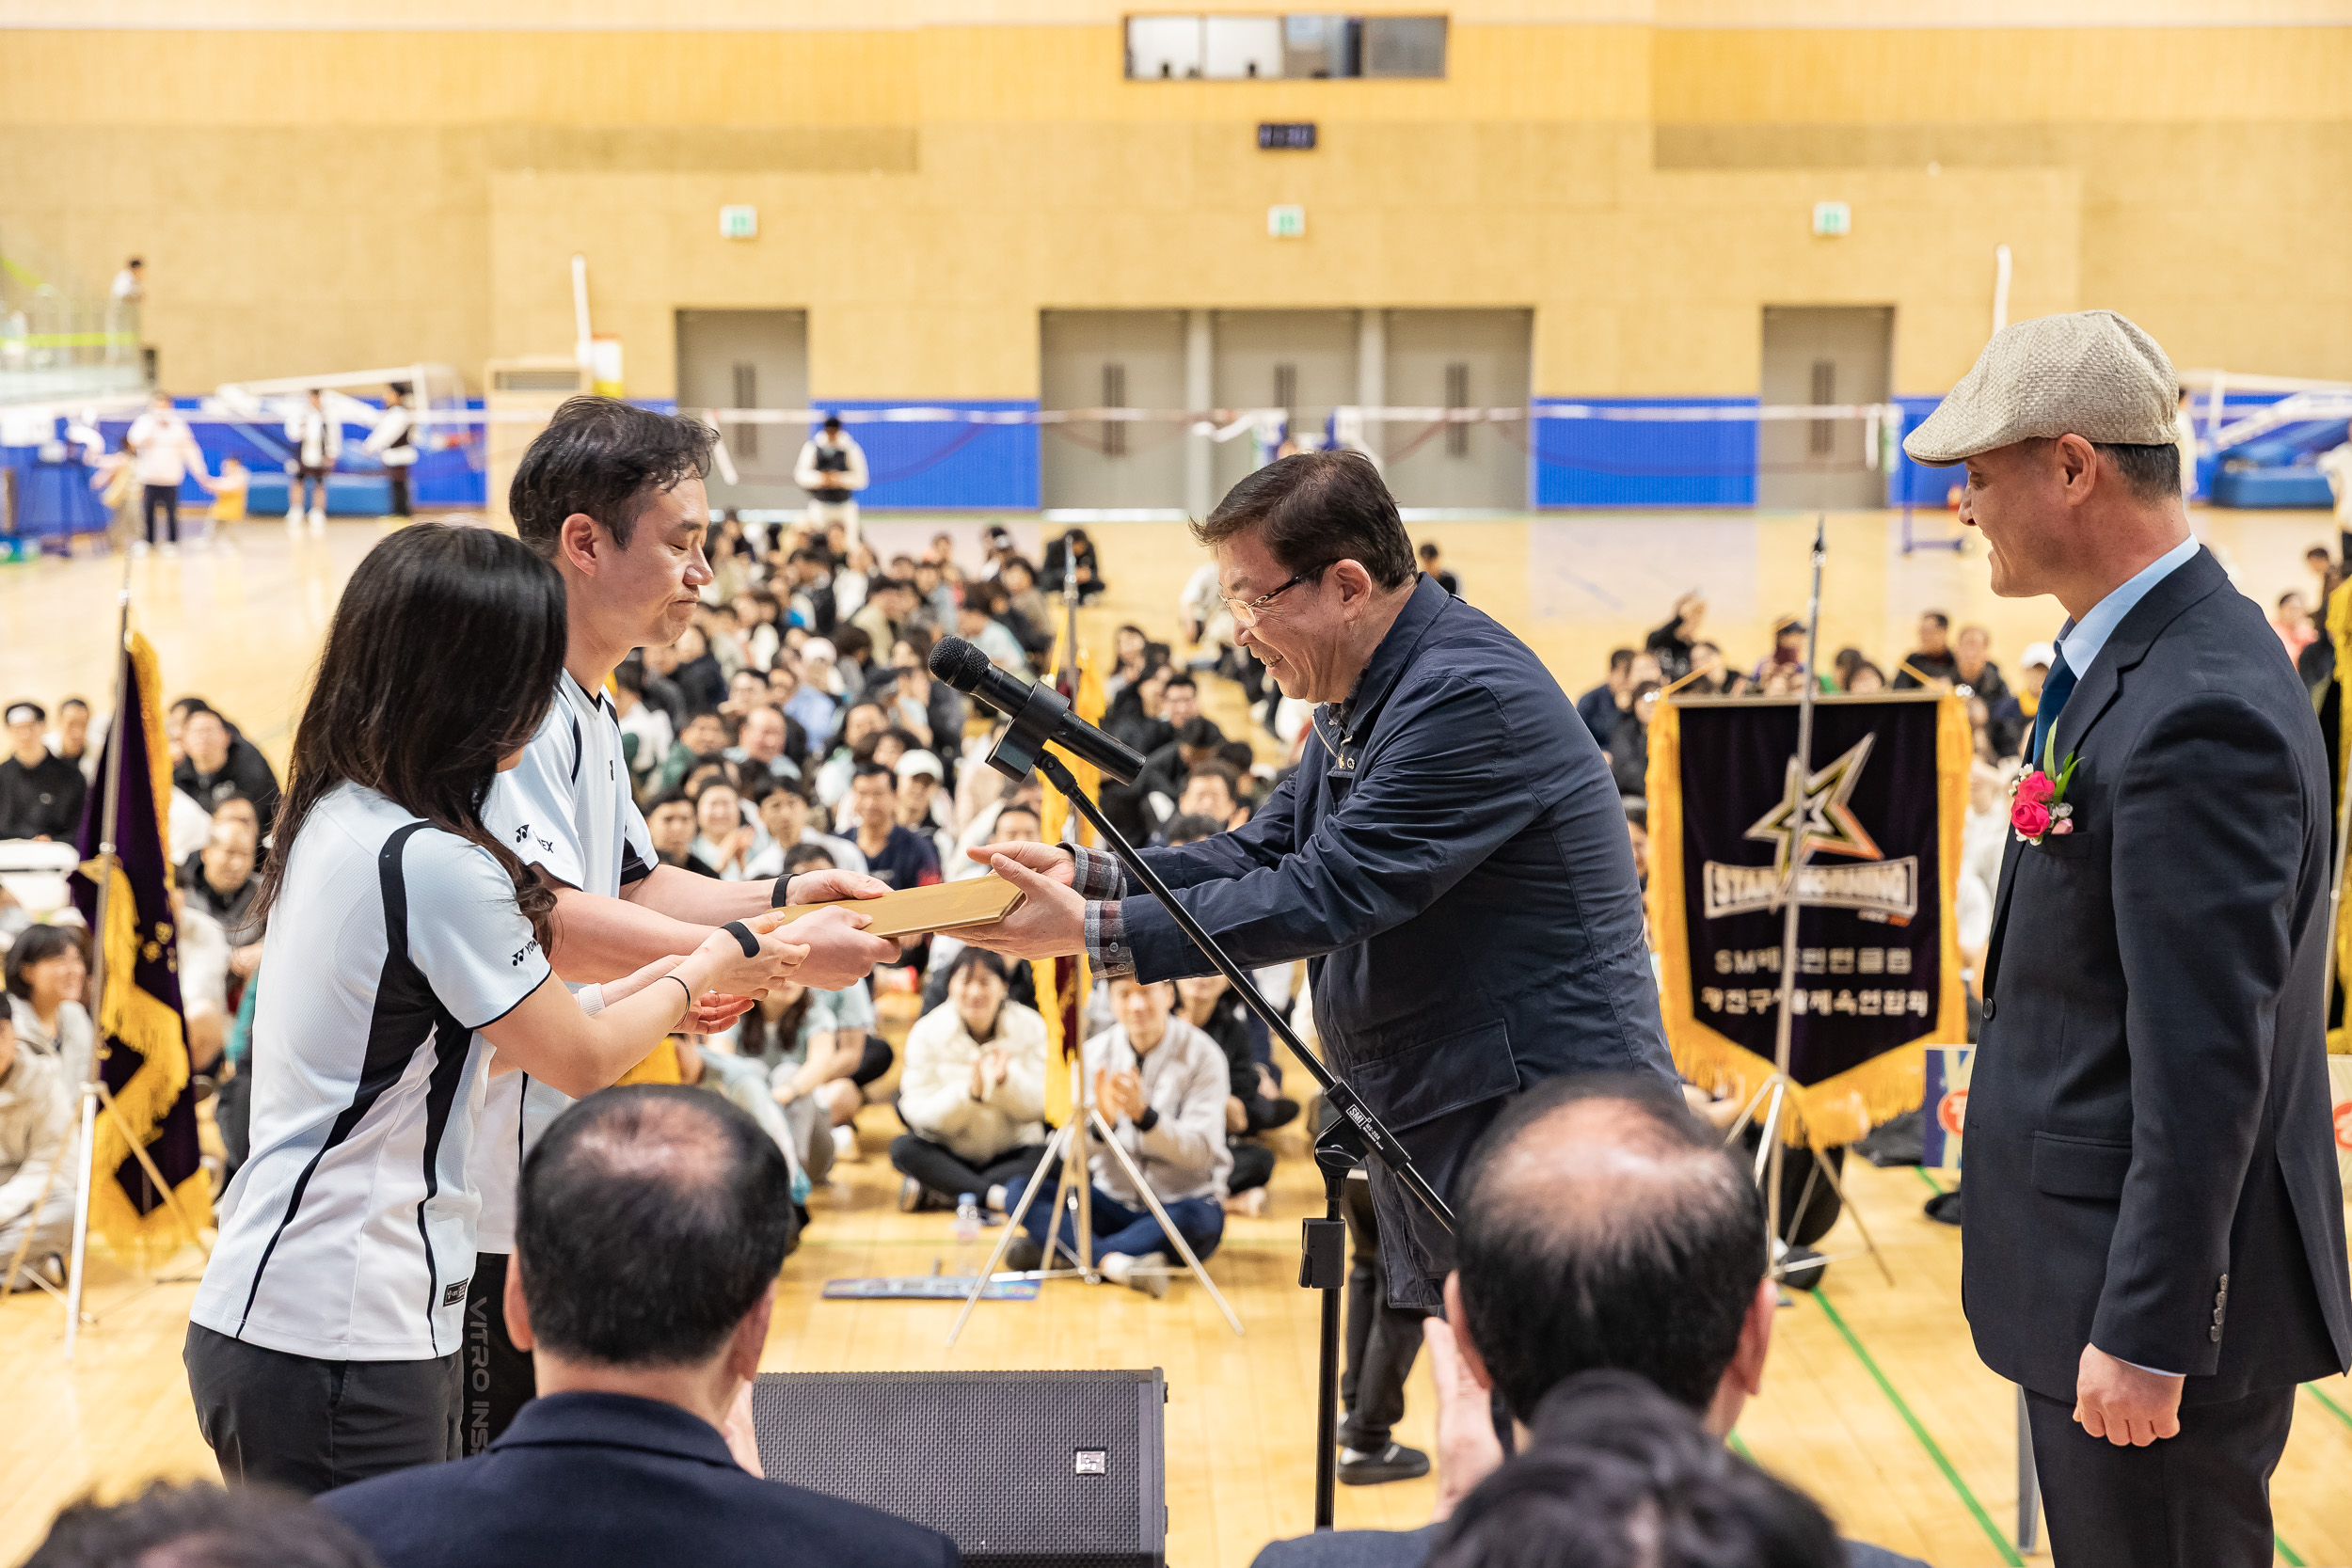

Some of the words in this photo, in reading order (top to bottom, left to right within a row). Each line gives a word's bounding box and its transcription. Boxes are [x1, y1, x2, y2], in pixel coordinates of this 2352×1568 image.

[1714, 945, 1912, 975] SM배민턴클럽
[1349, 1107, 1365, 1125] SMI
[469, 1296, 490, 1393] VITRO
[471, 1401, 490, 1455] INS
